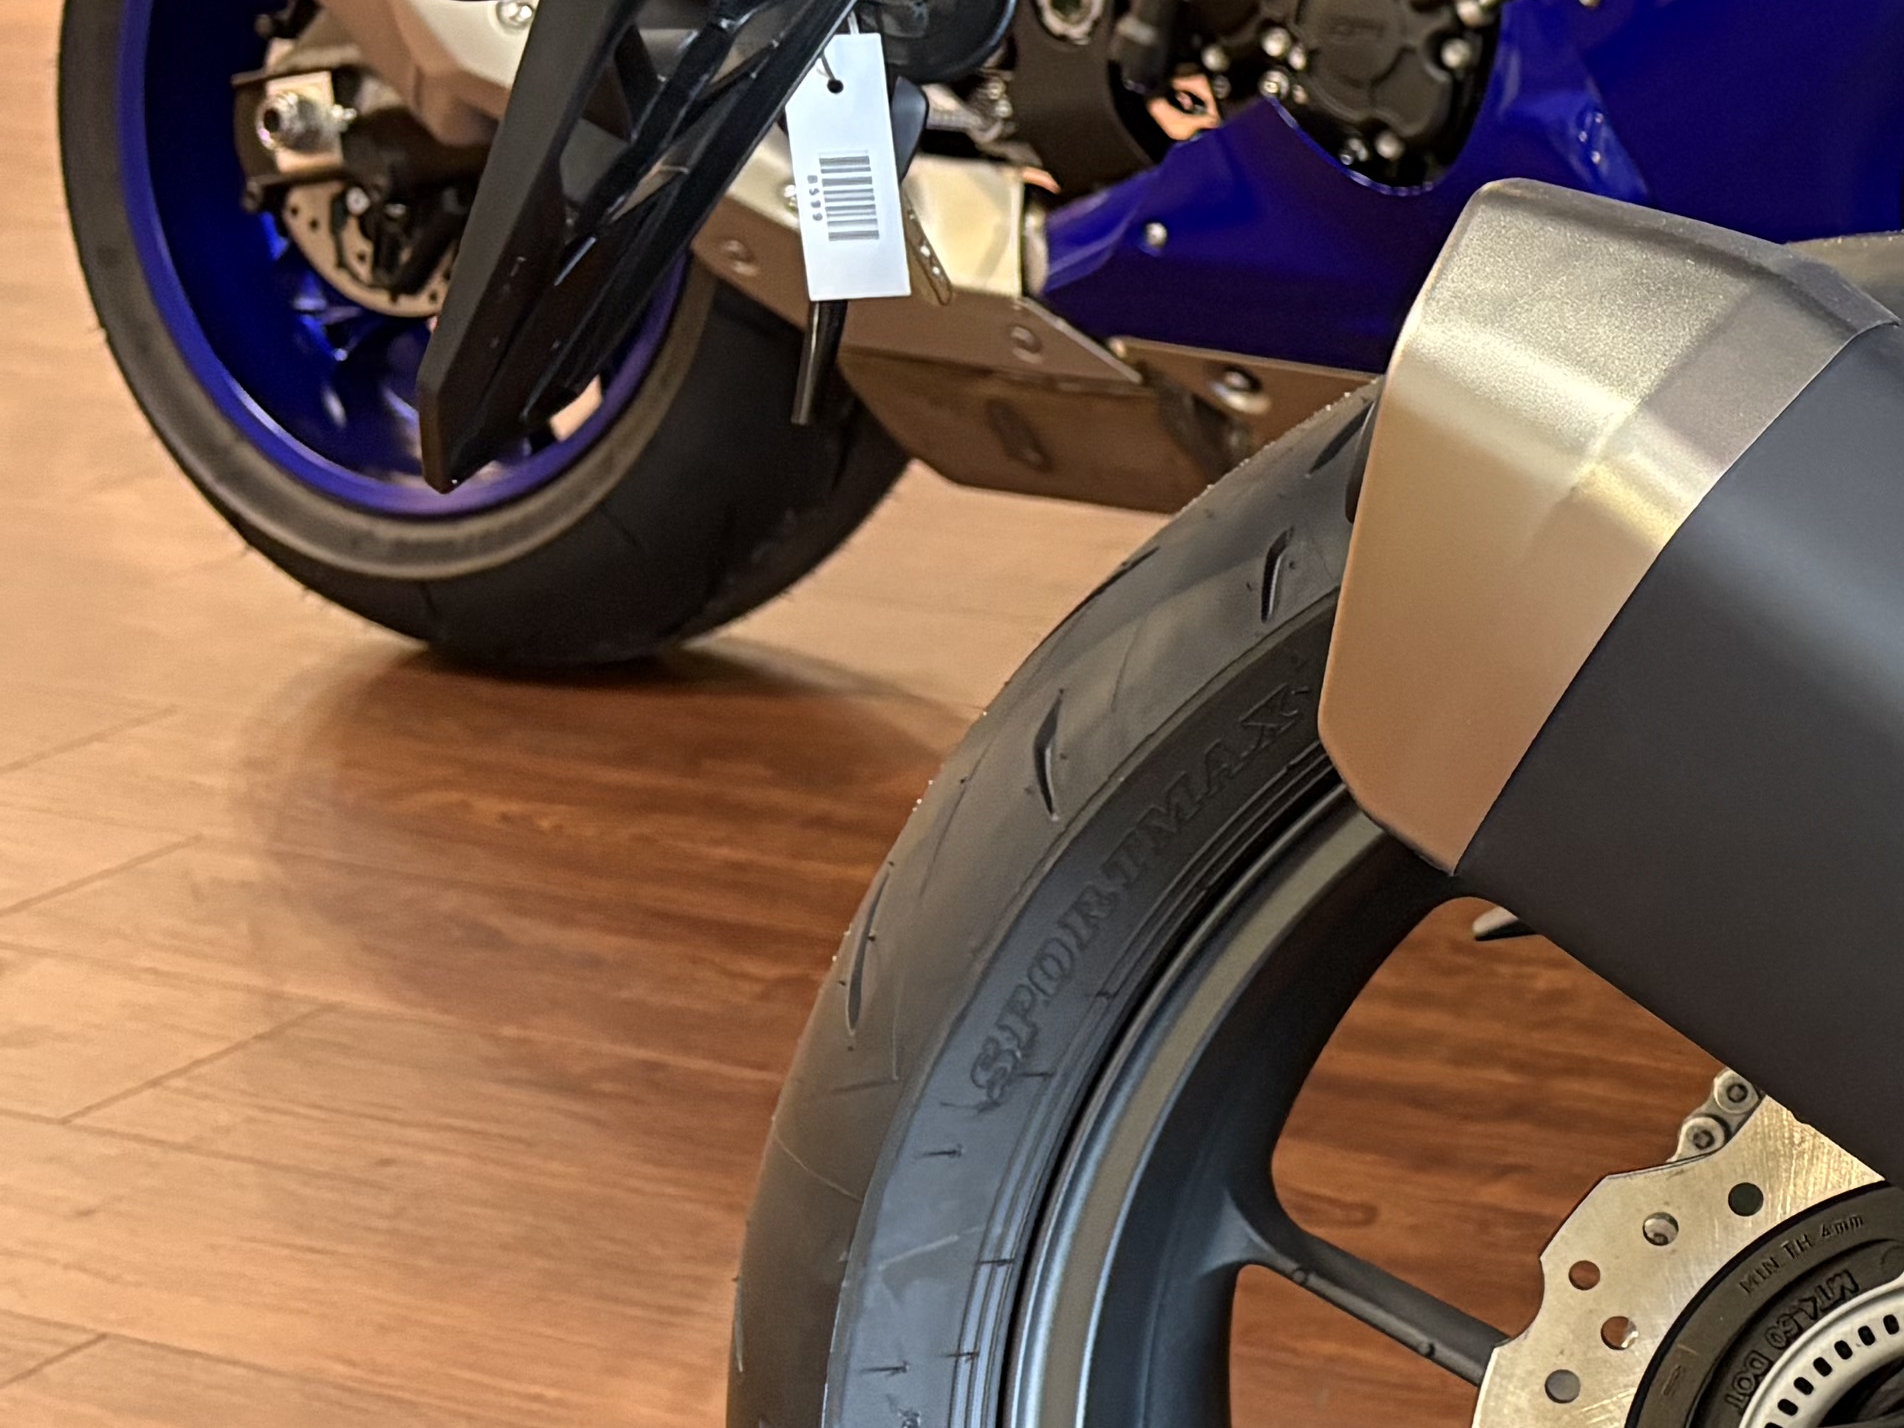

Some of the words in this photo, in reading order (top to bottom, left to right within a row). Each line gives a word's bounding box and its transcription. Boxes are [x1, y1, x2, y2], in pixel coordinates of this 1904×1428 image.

[970, 684, 1300, 1102] SPORTMAX
[1740, 1256, 1779, 1294] MIN
[1781, 1234, 1813, 1259] TH
[1725, 1349, 1771, 1409] DOT
